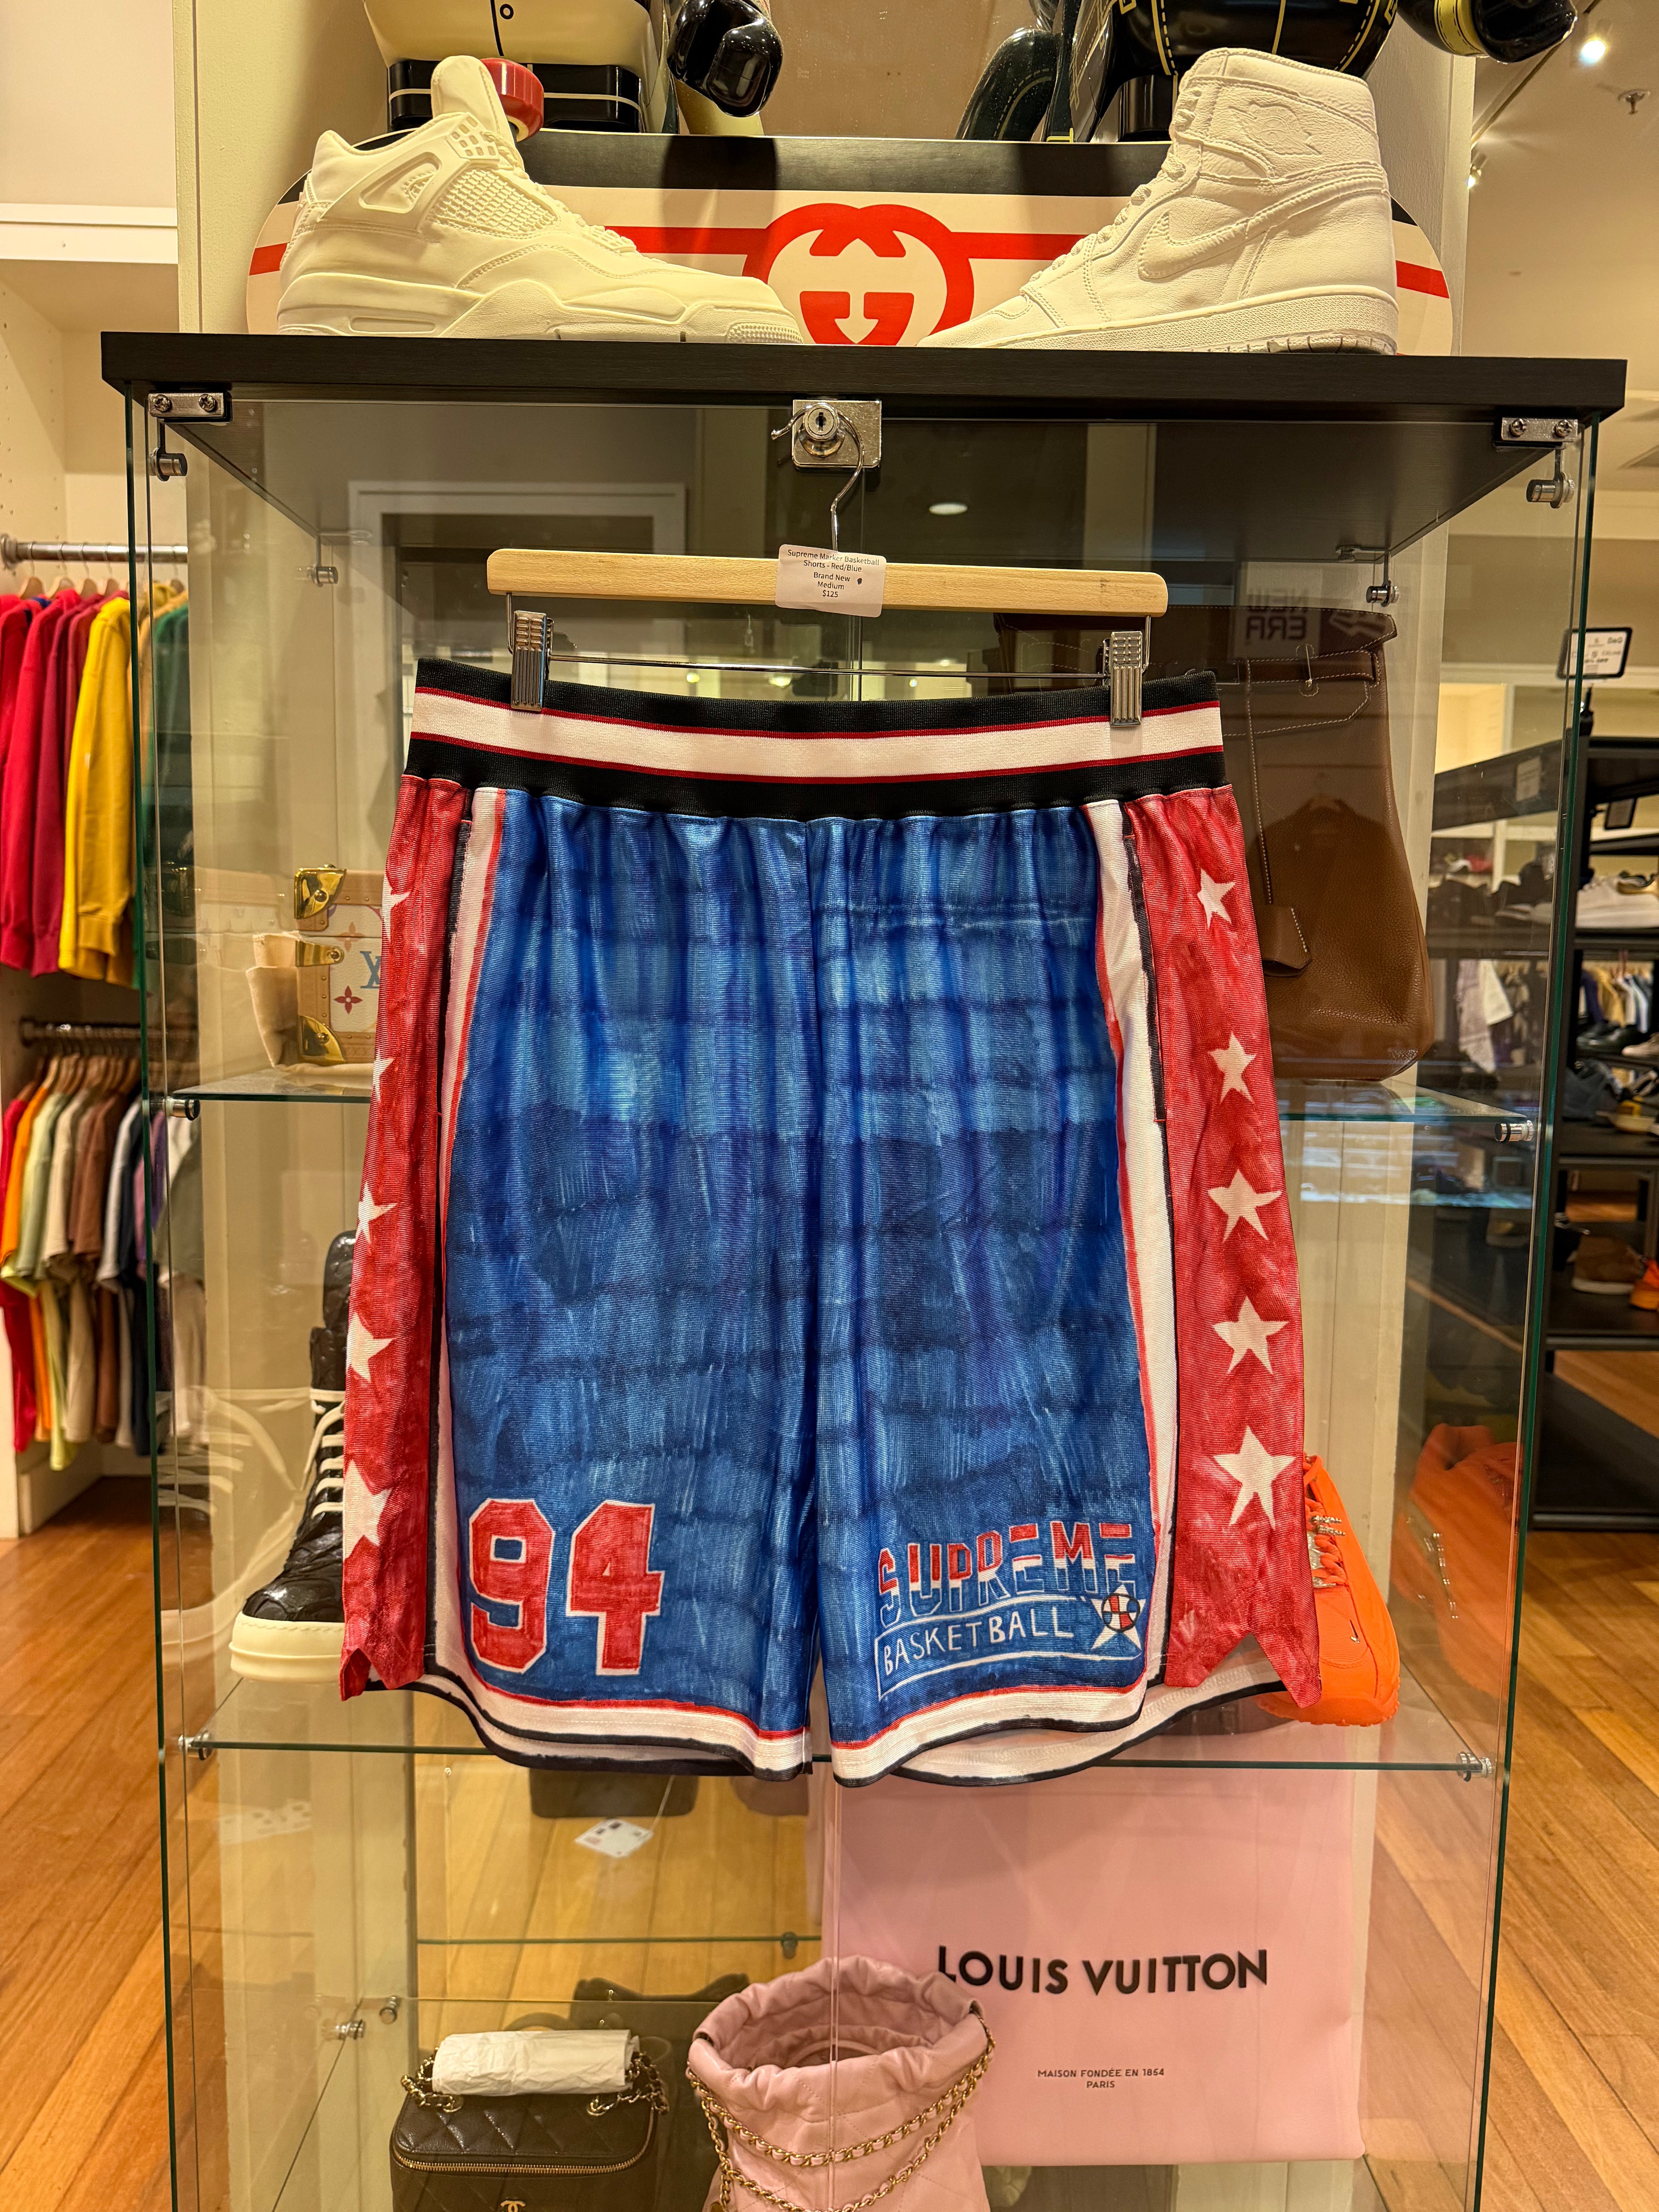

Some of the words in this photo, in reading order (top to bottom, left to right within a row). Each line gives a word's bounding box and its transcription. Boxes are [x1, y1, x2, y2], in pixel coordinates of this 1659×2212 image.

[788, 549, 818, 559] Supreme
[820, 553, 843, 562] Marker
[844, 556, 879, 566] Basketball
[803, 560, 826, 569] Shorts
[831, 563, 862, 572] Red/Blue
[817, 581, 844, 590] Medium
[878, 1521, 1136, 1629] SUPREME
[469, 1498, 665, 1676] 94
[883, 1605, 1074, 1677] BASKETBALL
[938, 1945, 1068, 1994] LOUIS
[1081, 1948, 1267, 1996] VUITTON
[1081, 2068, 1122, 2077] FONDÉE
[1086, 2080, 1115, 2088] PARIS
